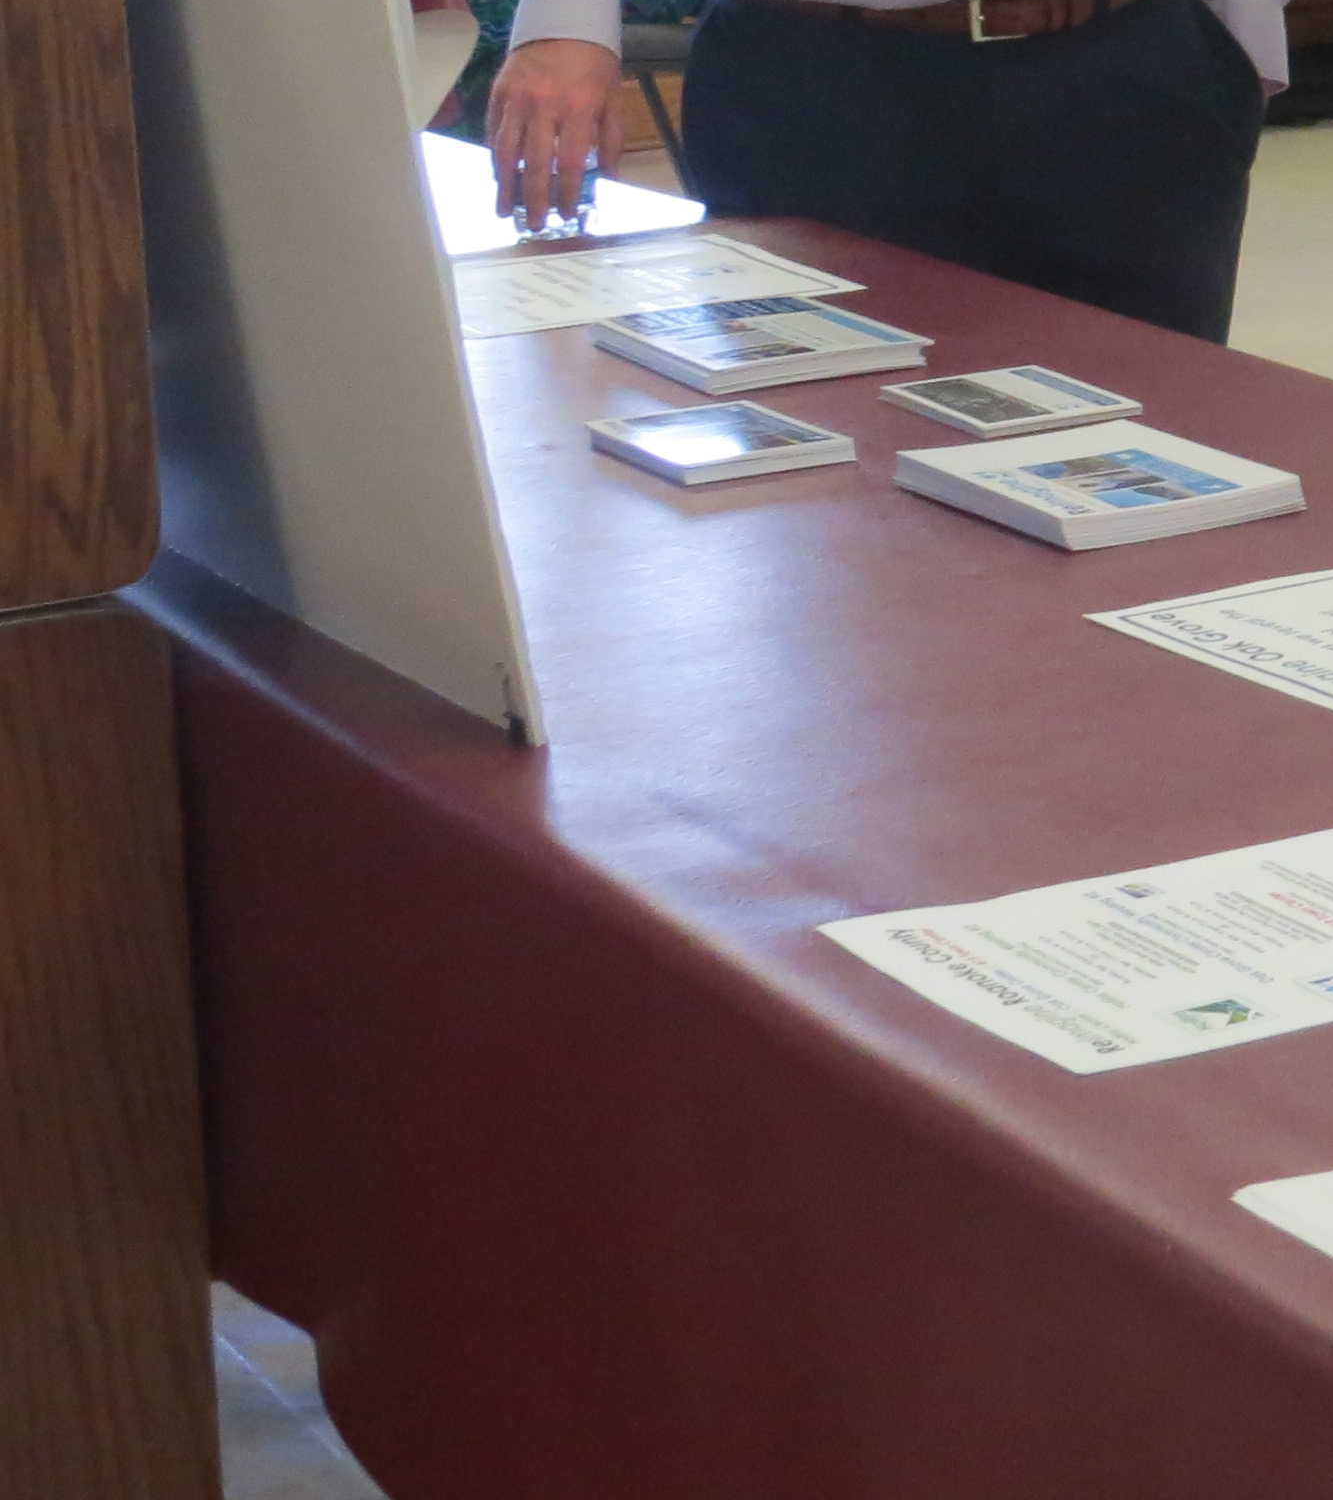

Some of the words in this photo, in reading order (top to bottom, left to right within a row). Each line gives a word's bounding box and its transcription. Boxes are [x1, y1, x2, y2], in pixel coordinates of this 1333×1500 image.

[1134, 612, 1238, 643] Grove
[1213, 640, 1290, 663] Oak
[872, 926, 964, 964] County
[935, 962, 1034, 1006] Roanoke
[1014, 1002, 1130, 1054] Reimagine
